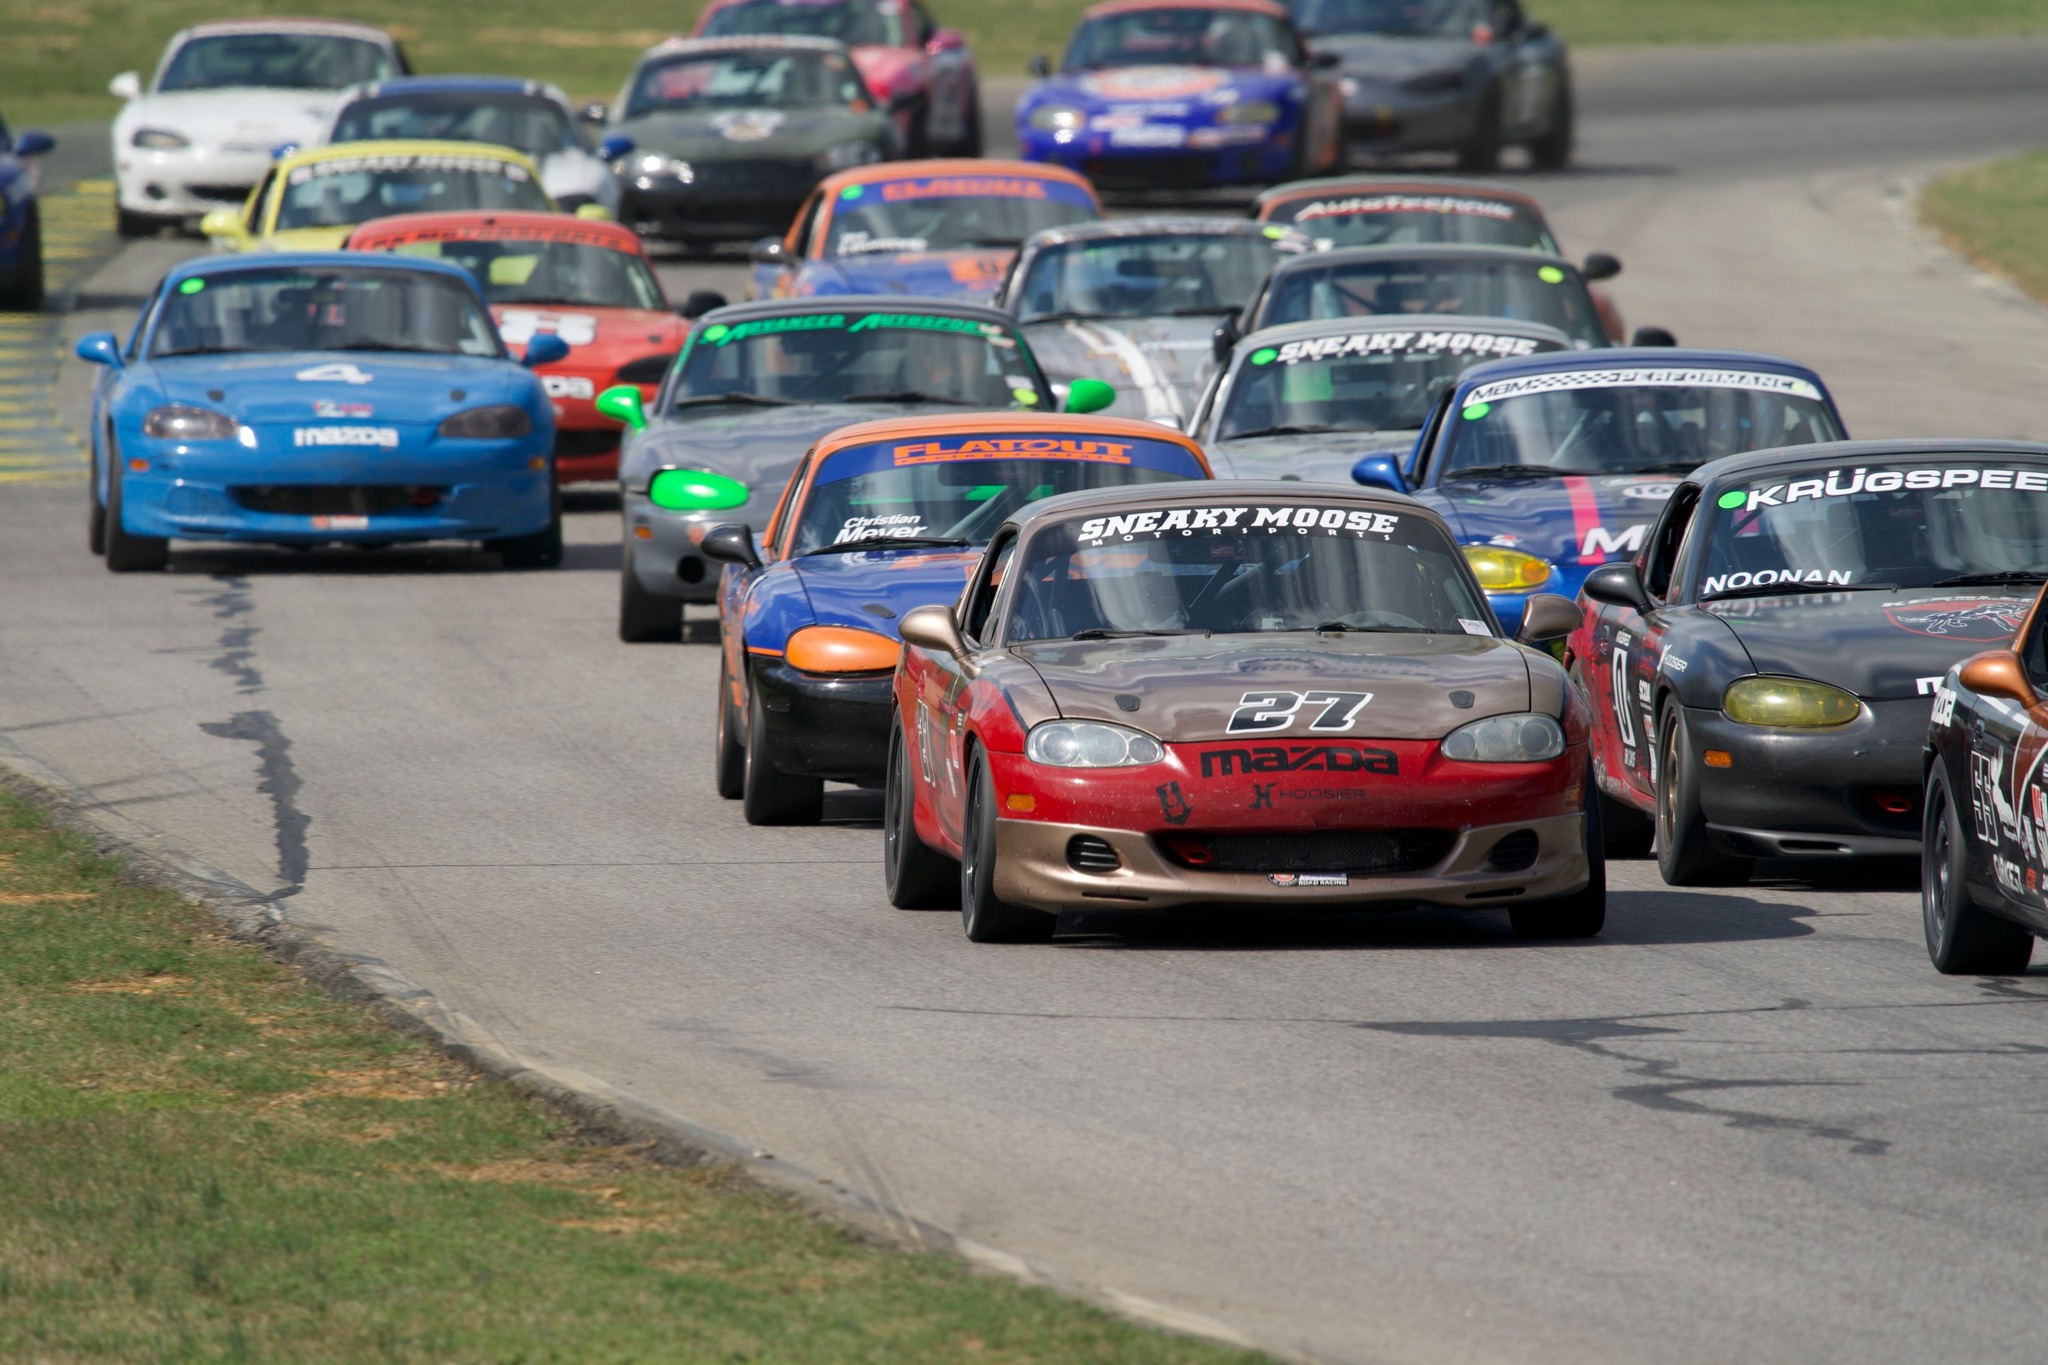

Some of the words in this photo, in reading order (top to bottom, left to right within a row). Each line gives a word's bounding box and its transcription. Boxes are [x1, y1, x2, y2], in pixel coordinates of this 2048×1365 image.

[848, 313, 990, 334] AUTOSPOR
[1277, 332, 1415, 362] SNEAKY
[1415, 332, 1538, 356] MOOSE
[296, 363, 374, 384] 4
[1471, 380, 1533, 402] MBM
[1618, 370, 1806, 391] PERFORMANC
[894, 439, 1132, 458] FLATOUT
[1745, 468, 2048, 511] KRÜGSPEE
[843, 514, 921, 529] Christian
[1077, 507, 1248, 541] SNEAKY
[1250, 507, 1399, 533] MOOSE
[1091, 527, 1391, 547] MOTORSPORTS
[1703, 569, 1852, 594] NOONAN
[1226, 690, 1374, 734] 27
[1279, 788, 1367, 800] HOOSIER
